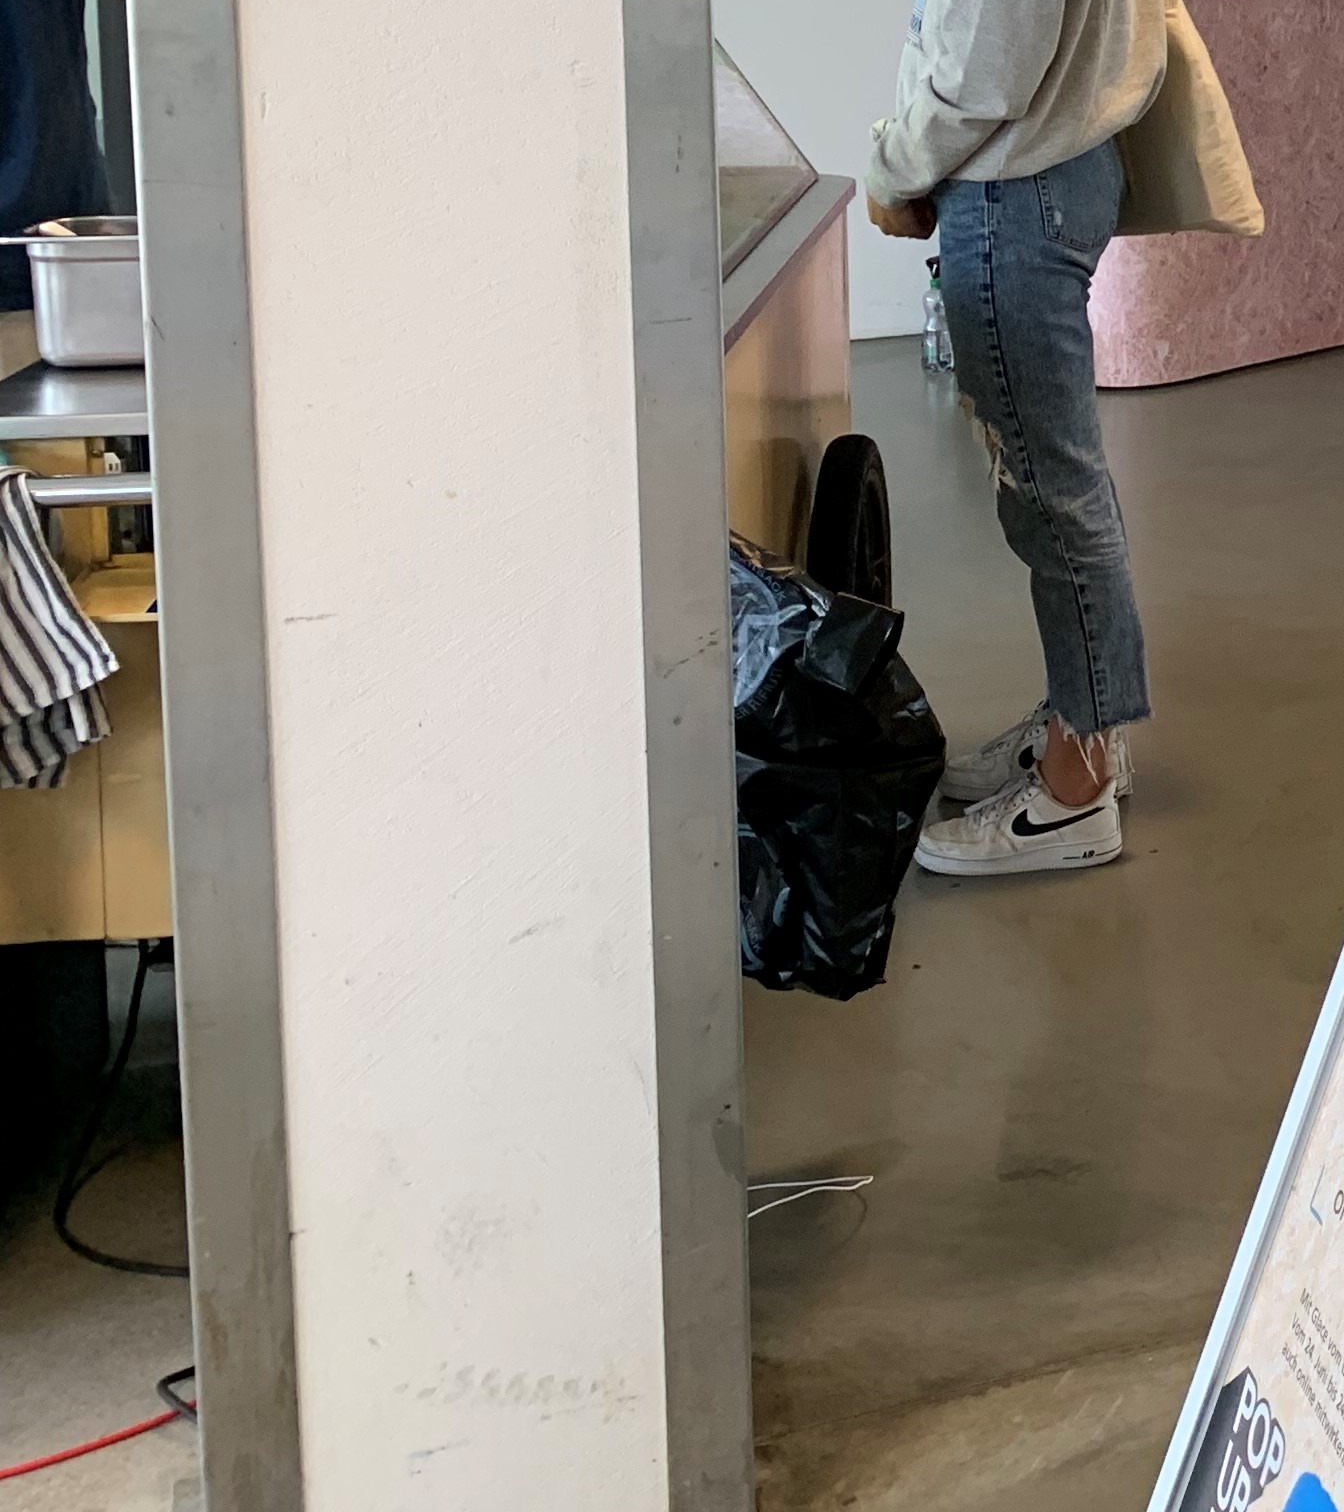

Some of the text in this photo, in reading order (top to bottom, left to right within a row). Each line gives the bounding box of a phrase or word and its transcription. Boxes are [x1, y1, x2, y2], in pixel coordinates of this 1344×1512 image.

[1291, 1311, 1306, 1346] Vom
[1304, 1337, 1315, 1364] 24.
[1313, 1355, 1329, 1386] Juni
[1326, 1375, 1338, 1403] bis
[1299, 1287, 1313, 1316] Mit
[1311, 1306, 1329, 1344] Glace
[1327, 1337, 1343, 1367] vom
[1281, 1341, 1298, 1373] auch
[1296, 1367, 1317, 1408] online
[1232, 1372, 1285, 1487] POP
[1217, 1438, 1251, 1512] UP
